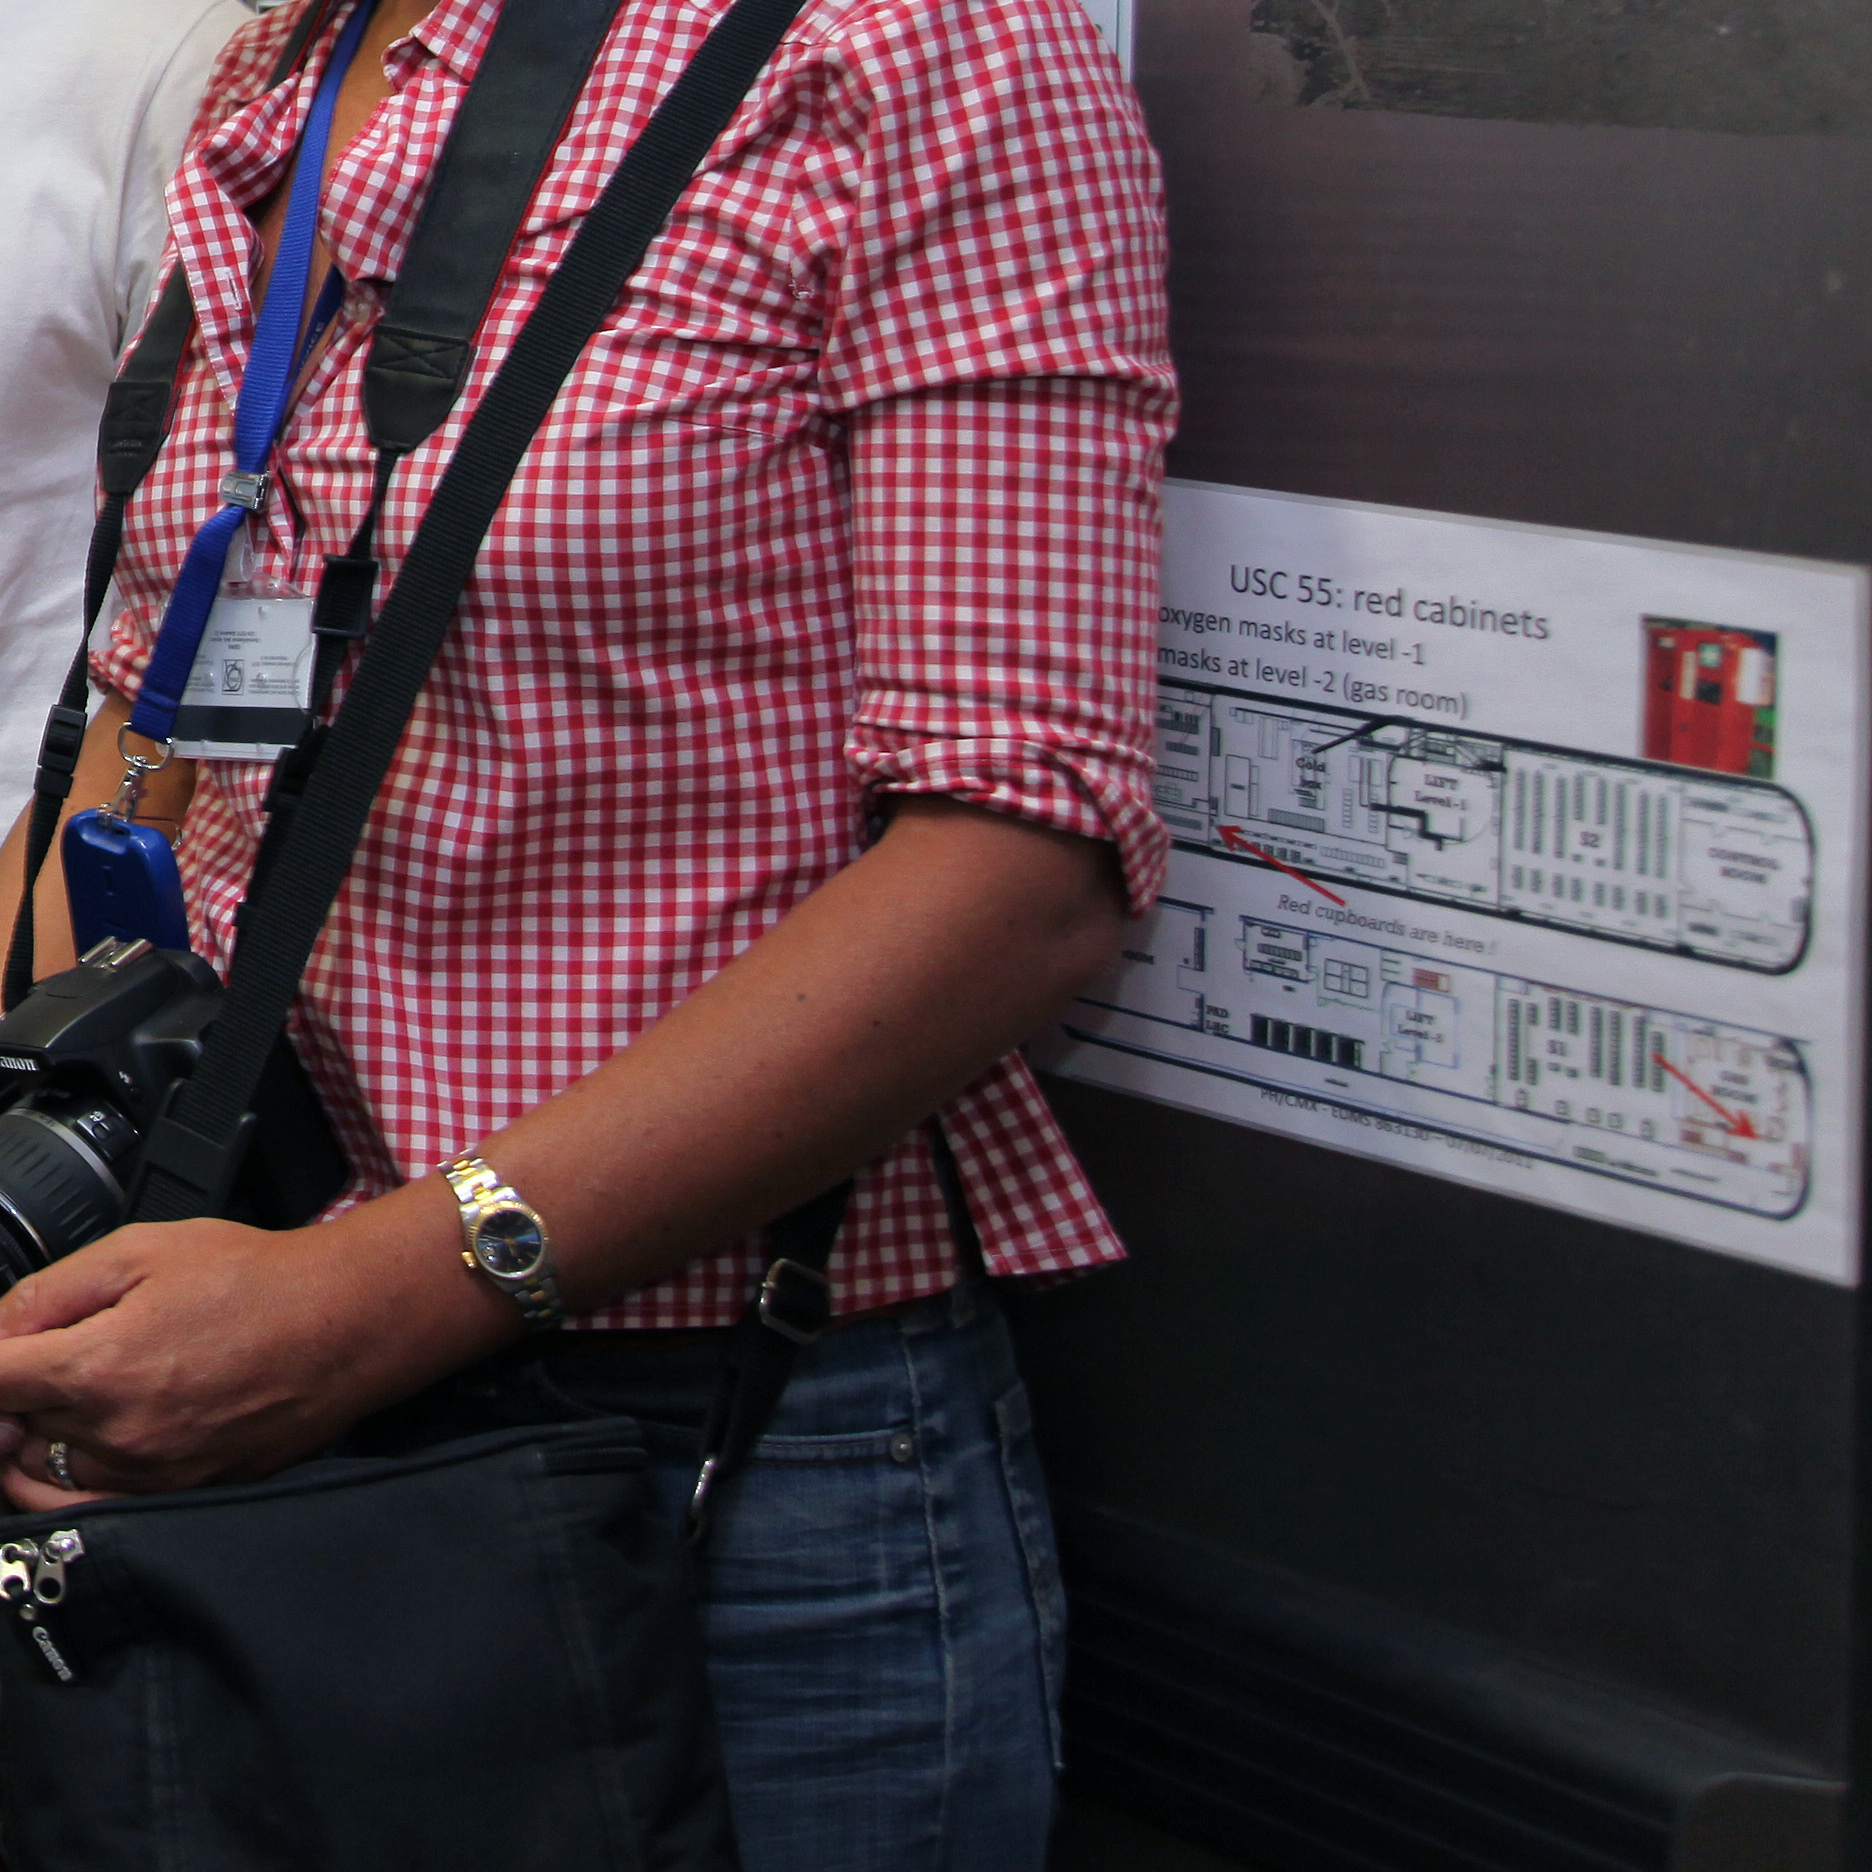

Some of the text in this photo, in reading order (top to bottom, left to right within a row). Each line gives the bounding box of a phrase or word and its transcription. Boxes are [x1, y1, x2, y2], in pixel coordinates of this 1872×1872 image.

[1230, 564, 1550, 642] USC 55: red cabinets
[1238, 616, 1307, 647] masks
[1313, 629, 1335, 650] at
[1342, 629, 1395, 661] level
[1400, 642, 1426, 666] -1
[1157, 646, 1469, 721] masks at level -2 (gas room)
[1295, 756, 1327, 774] Cold
[1277, 893, 1313, 916] Red
[1314, 902, 1407, 937] cupboards
[1409, 926, 1440, 944] are
[1442, 929, 1486, 955] here
[1259, 1088, 1320, 1114] PH/CMX
